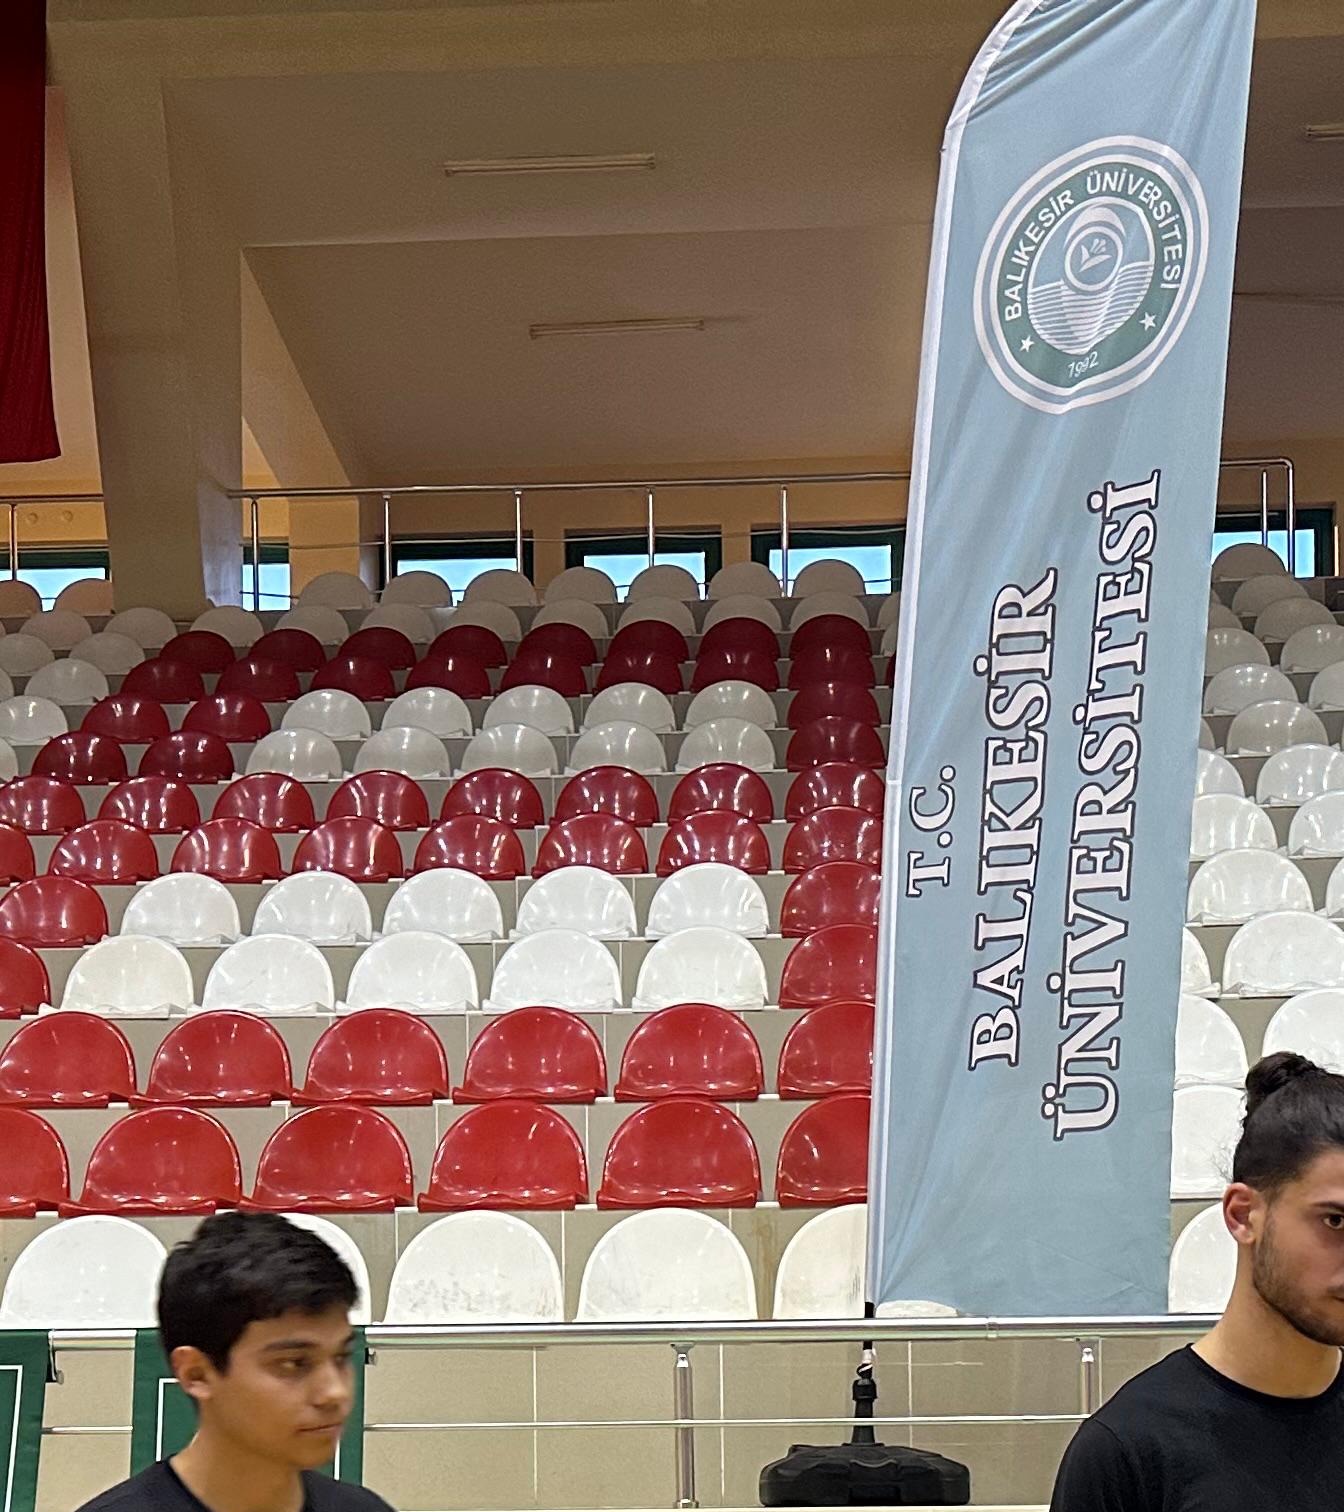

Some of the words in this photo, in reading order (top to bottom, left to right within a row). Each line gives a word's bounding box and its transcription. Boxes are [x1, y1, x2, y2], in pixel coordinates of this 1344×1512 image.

[1004, 189, 1074, 321] BALIKESİR
[1067, 351, 1099, 379] 1992
[906, 764, 956, 898] T.C.
[969, 567, 1058, 1070] BALIKESİR
[1042, 469, 1161, 1141] ÜNİVERSİTESİ
